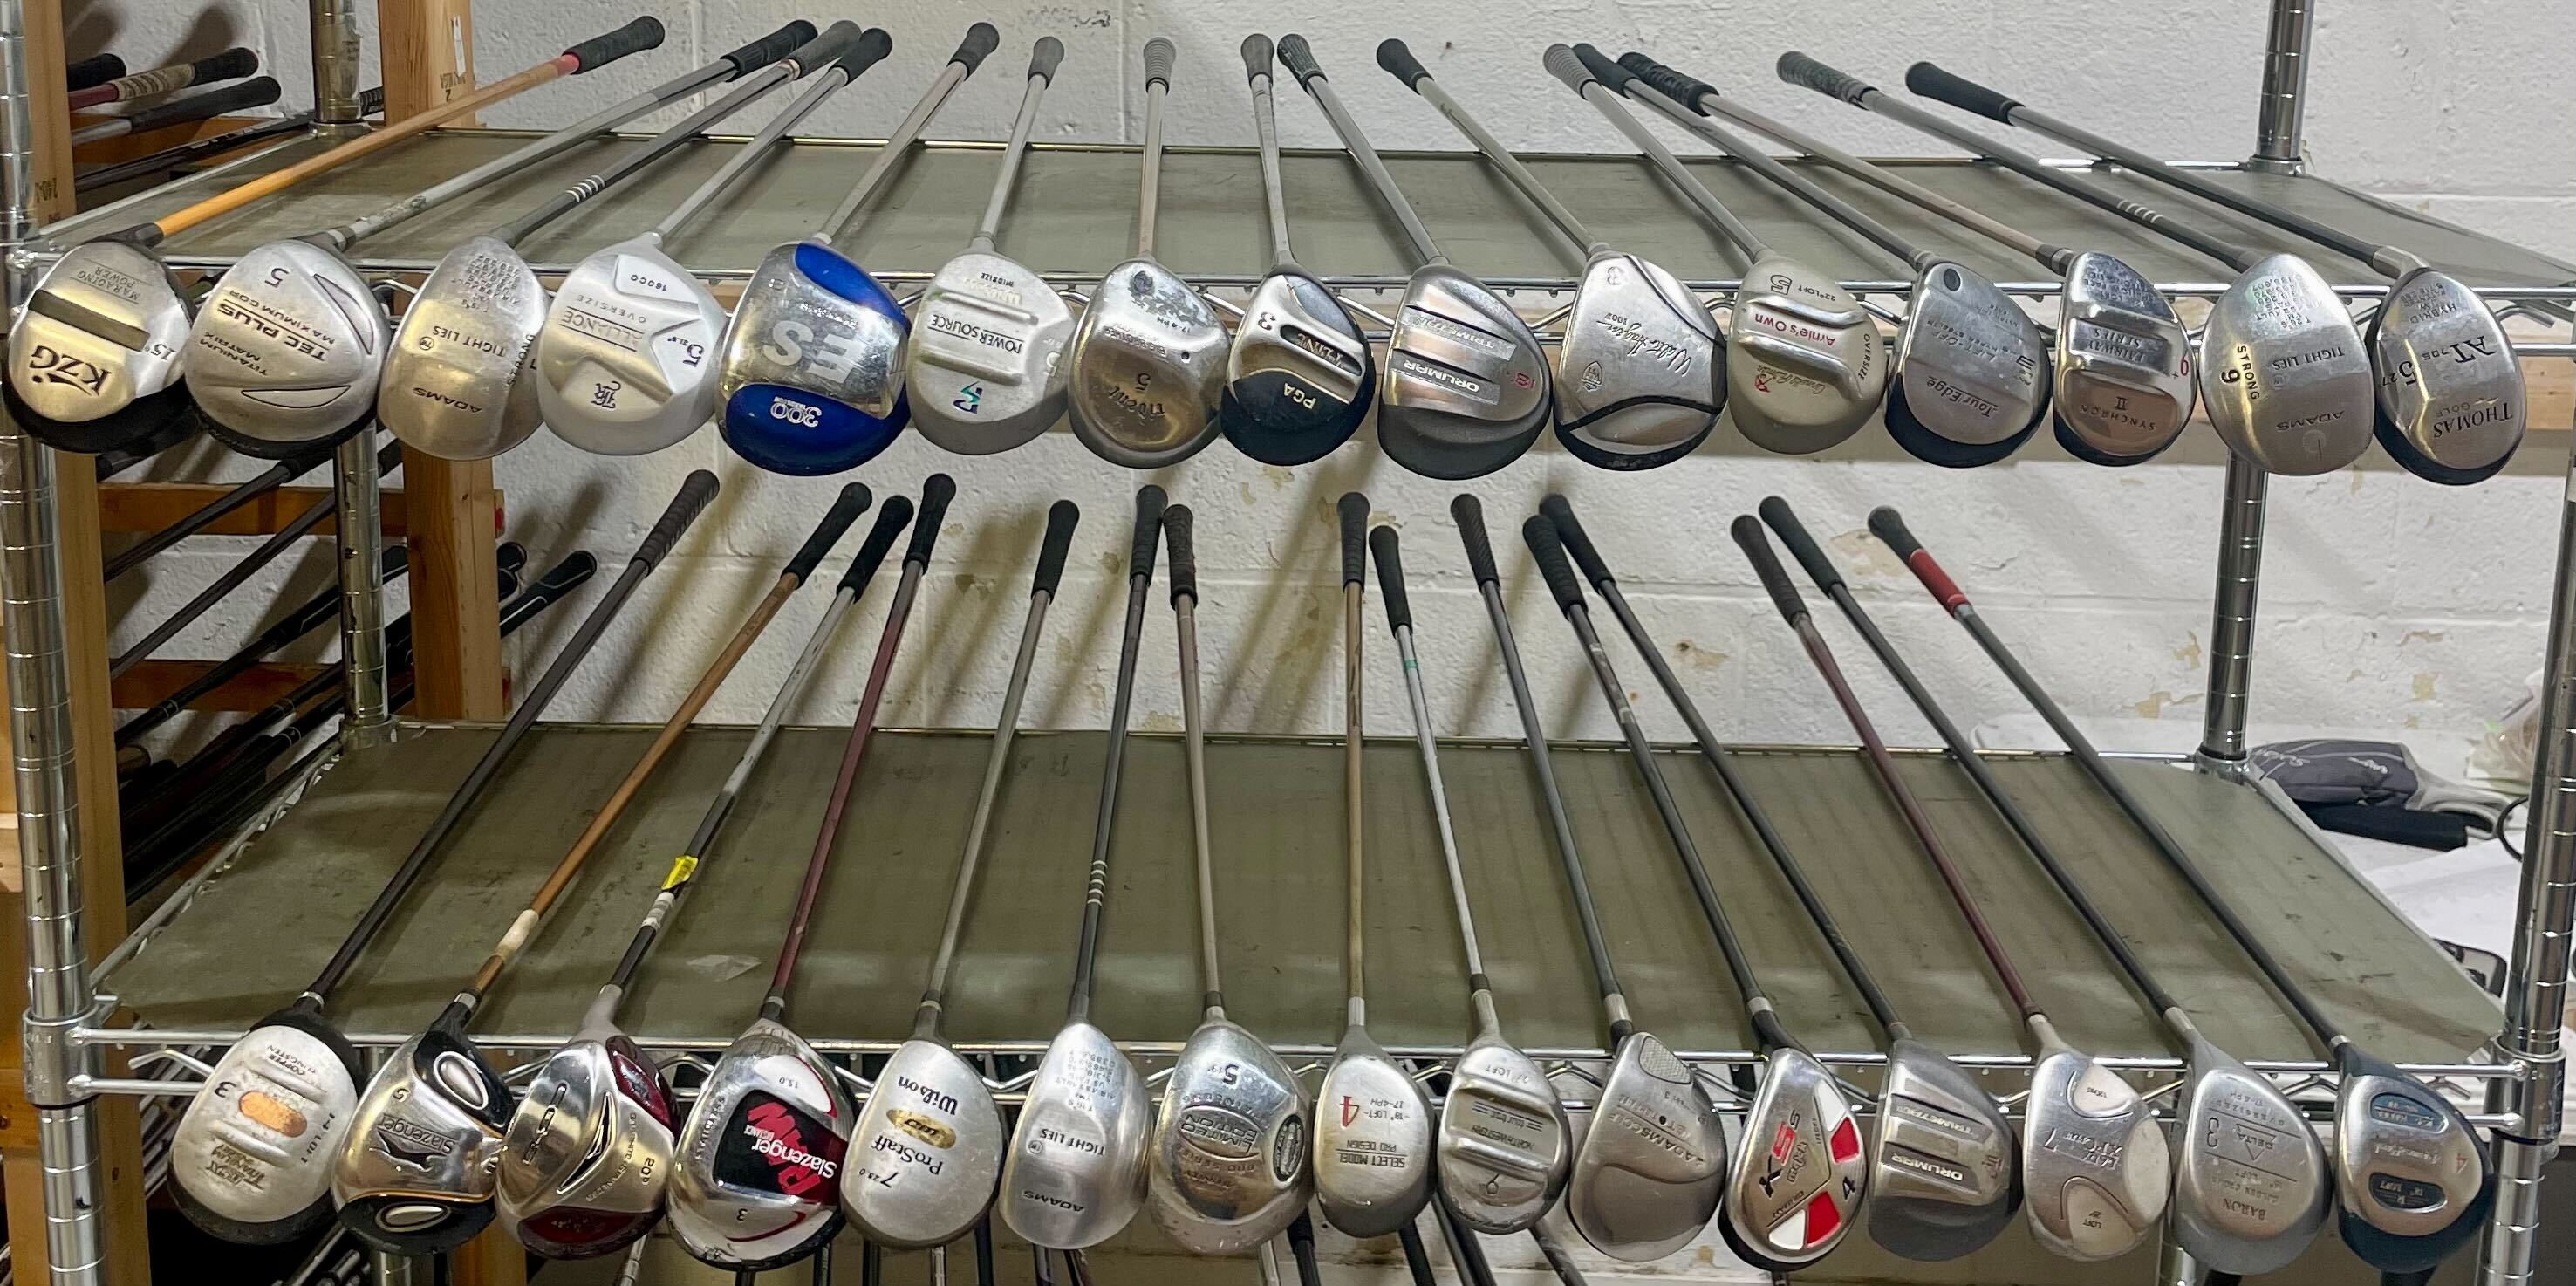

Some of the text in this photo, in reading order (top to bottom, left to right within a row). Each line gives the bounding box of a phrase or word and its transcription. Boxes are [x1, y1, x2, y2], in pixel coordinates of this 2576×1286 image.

[94, 265, 136, 289] POWER
[264, 268, 289, 289] 5
[630, 274, 667, 292] 160CC
[1607, 267, 1623, 286] 3
[1770, 274, 1792, 296] 5
[229, 289, 335, 345] MAXIMUM COR
[577, 295, 646, 324] OVERSIZE
[1257, 311, 1275, 331] 3
[2409, 303, 2457, 324] HYBRID
[216, 303, 326, 362] TEC PLUS
[560, 310, 642, 347] ALLIANCE
[931, 314, 980, 338] SOURCE
[1753, 314, 1835, 346] Arnie's Own
[2094, 327, 2141, 347] SERIES
[204, 331, 261, 362] MATRIX
[432, 325, 506, 358] TIGHT LIES
[760, 320, 868, 384] ES
[978, 332, 1022, 354] POWER
[1596, 321, 1692, 378] Walter Hagen
[2085, 339, 2143, 362] FAIRWAY
[2450, 335, 2496, 364] AT
[199, 339, 268, 376] TITANIUM
[682, 344, 705, 367] 5
[1856, 333, 1871, 380] OVERSIZE
[2271, 346, 2345, 371] TIGHT LIES
[29, 345, 111, 396] KZG
[1135, 373, 1151, 392] 5
[1404, 359, 1479, 393] ORLIMAR
[2236, 345, 2260, 400] STRONG
[2398, 360, 2417, 386] 5
[412, 386, 482, 414] ADAMS
[1283, 382, 1316, 409] PGA
[1926, 376, 1993, 418] Tour Edge
[769, 402, 822, 428] 300
[2080, 404, 2156, 431] SYNCHRON
[2276, 410, 2345, 432] ADAMS
[2432, 402, 2513, 438] THOMAS
[268, 1054, 305, 1077] COPPER
[1222, 1064, 1240, 1085] 5
[1485, 1064, 1512, 1079] LOFT
[214, 1081, 237, 1098] 3
[778, 1076, 799, 1090] 15.0
[897, 1076, 959, 1117] Wilson
[1339, 1096, 1360, 1129] 4
[376, 1114, 456, 1153] Slazenger
[1180, 1122, 1253, 1154] LIMITED
[1186, 1114, 1258, 1142] EDITION
[1471, 1124, 1534, 1151] NORTHWESTERN
[2043, 1127, 2058, 1153] 7
[2206, 1117, 2220, 1148] 3
[870, 1134, 943, 1176] ProStaff
[1039, 1127, 1106, 1157] TIGHT LIES
[1346, 1139, 1397, 1153] PRO DESIGN
[2236, 1132, 2273, 1152] DELTA
[750, 1138, 837, 1179] Slazenger
[1338, 1153, 1405, 1168] SELECT MODEL
[1890, 1153, 1964, 1181] ORLIMAR
[879, 1171, 899, 1188] 7
[1842, 1176, 1855, 1200] 4
[1022, 1189, 1085, 1213] ADAMS
[2223, 1198, 2266, 1221] BARON
[735, 1208, 748, 1221] 3
